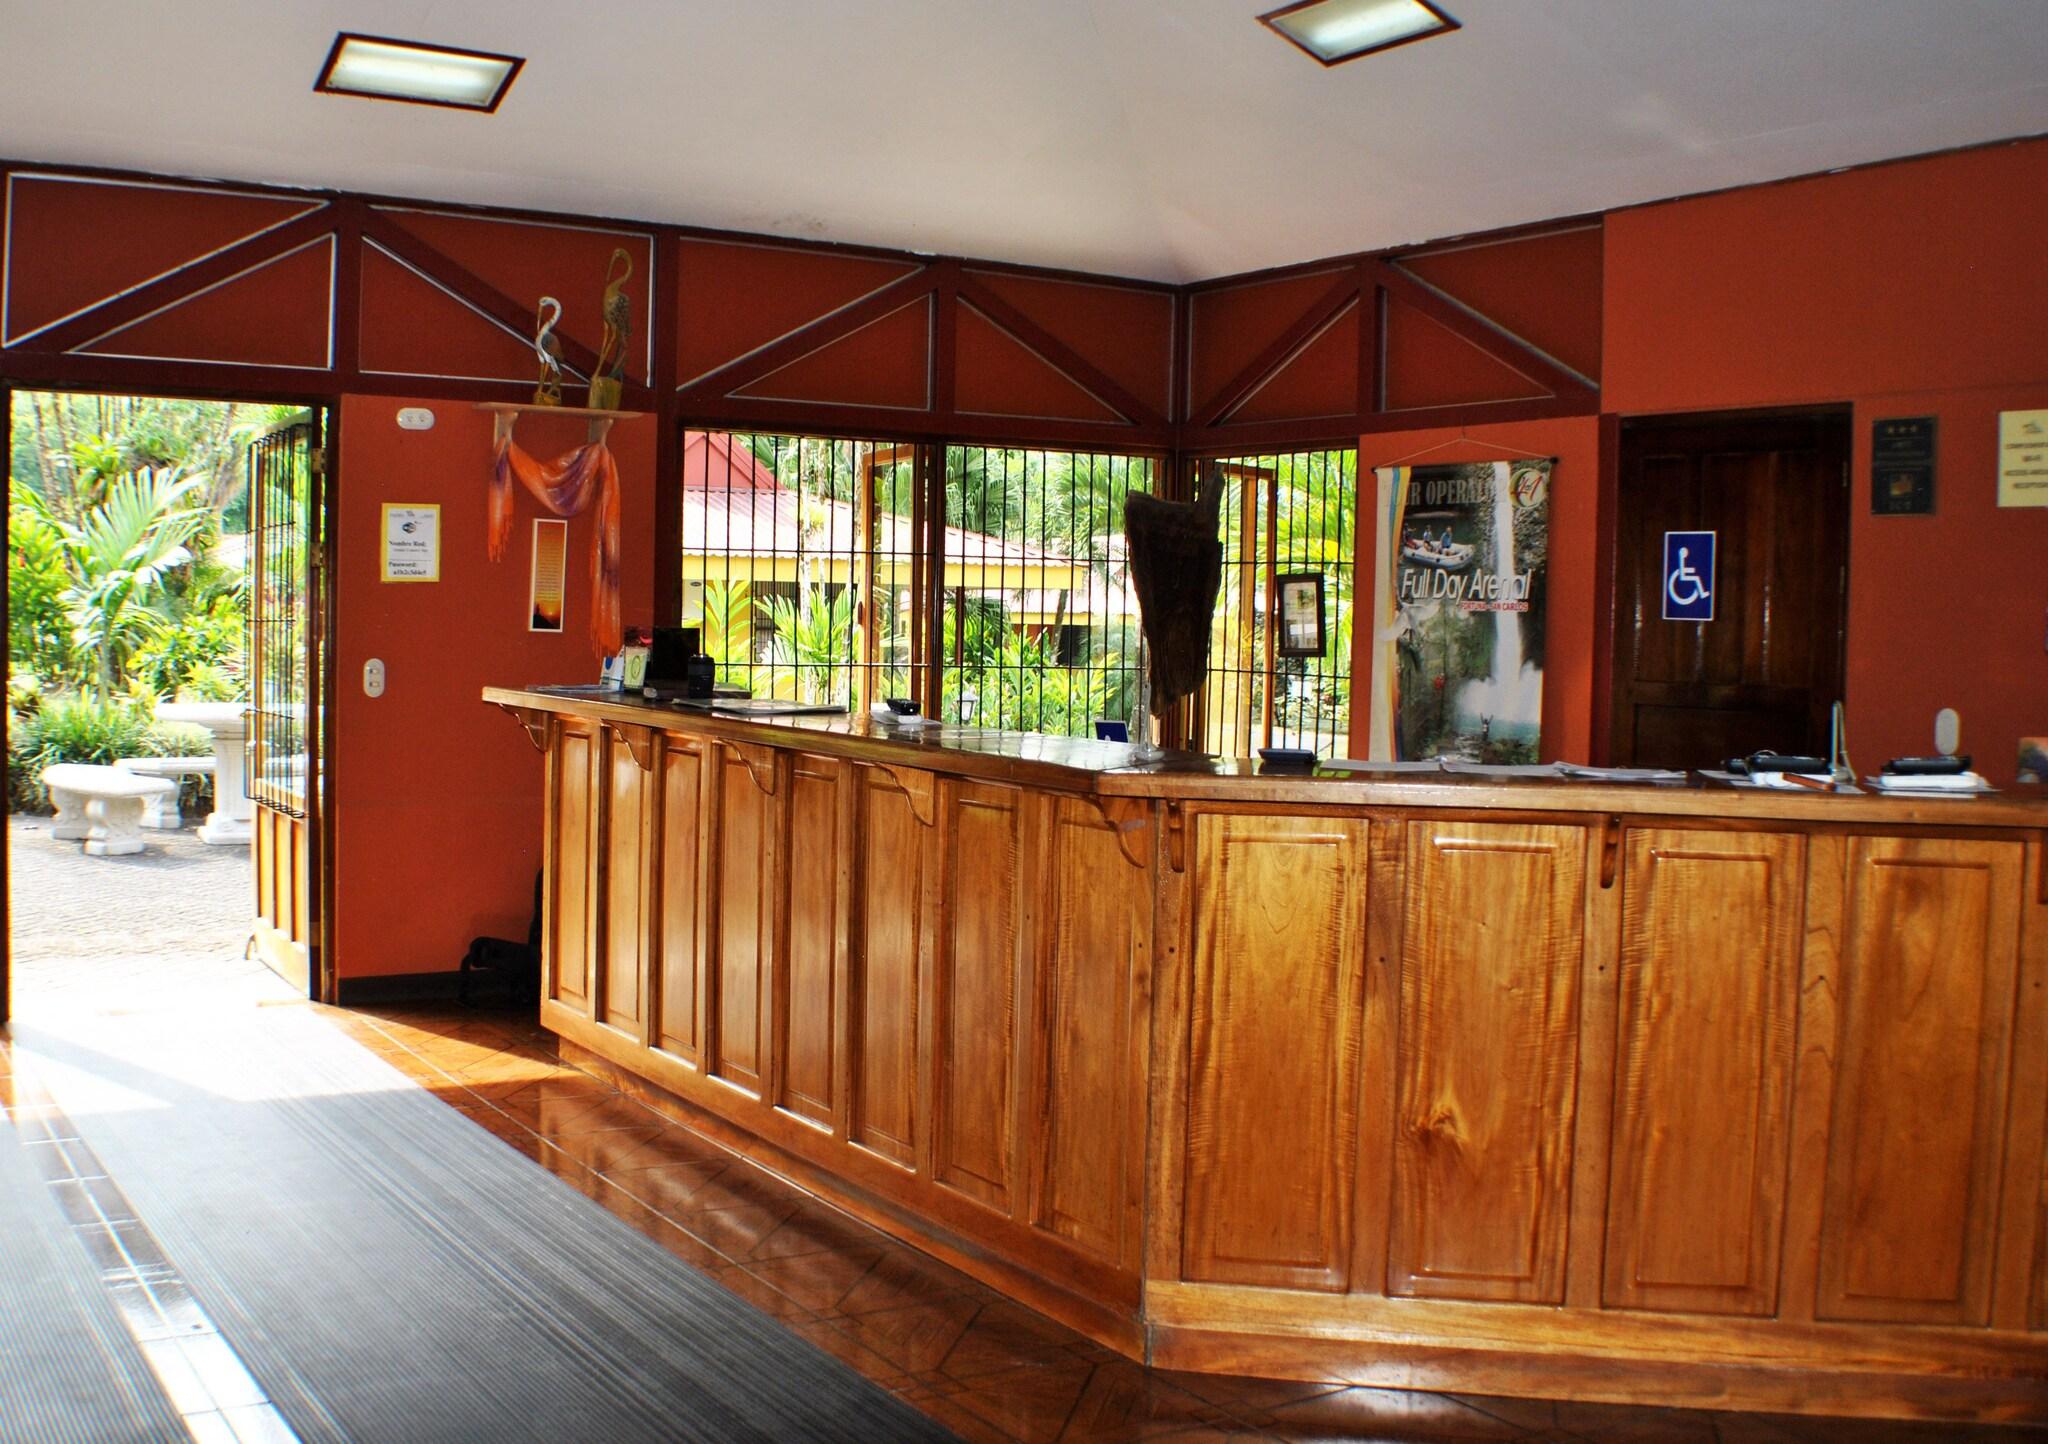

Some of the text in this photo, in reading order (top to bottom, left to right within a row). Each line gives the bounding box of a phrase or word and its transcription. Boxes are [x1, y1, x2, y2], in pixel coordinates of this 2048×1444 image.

[1401, 568, 1532, 604] Full Day Arenal
[1503, 601, 1529, 612] CARLOS
